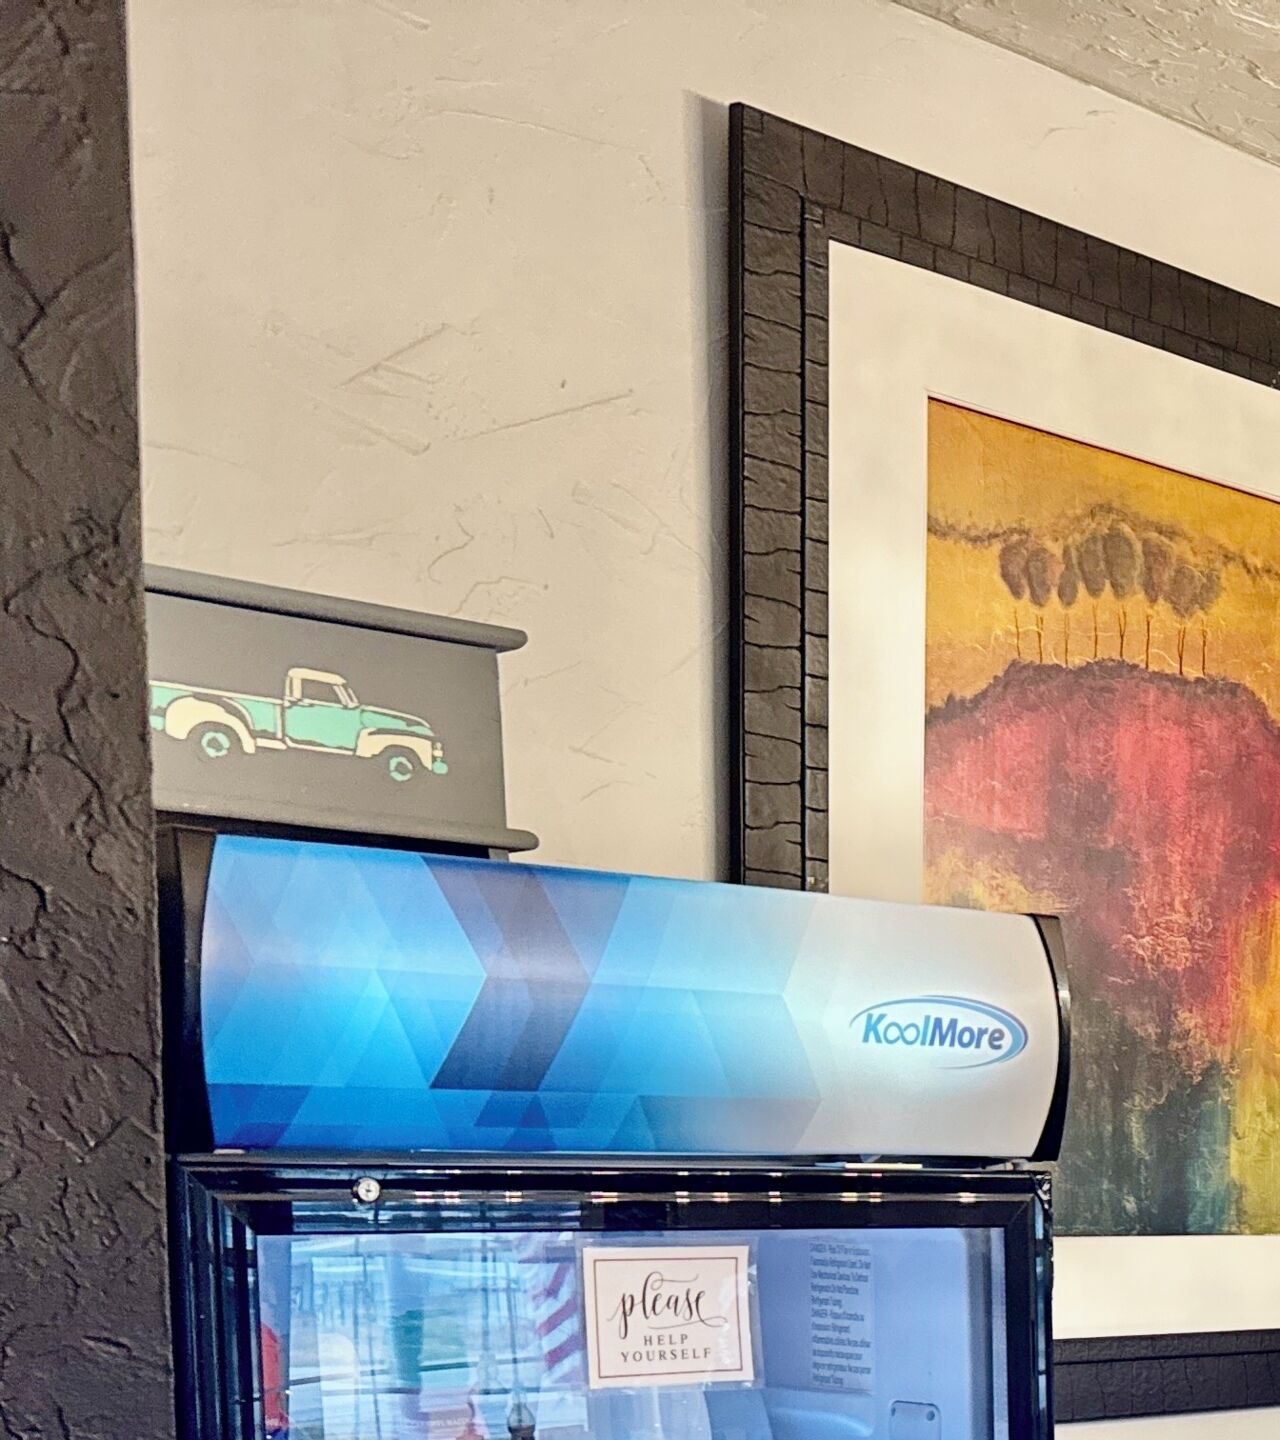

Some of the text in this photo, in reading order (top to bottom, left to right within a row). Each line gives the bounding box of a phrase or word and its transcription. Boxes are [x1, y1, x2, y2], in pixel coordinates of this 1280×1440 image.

[861, 1012, 1006, 1051] KoolMore
[606, 1271, 728, 1340] please
[643, 1333, 689, 1347] HELP
[620, 1347, 712, 1363] YOURSELF
